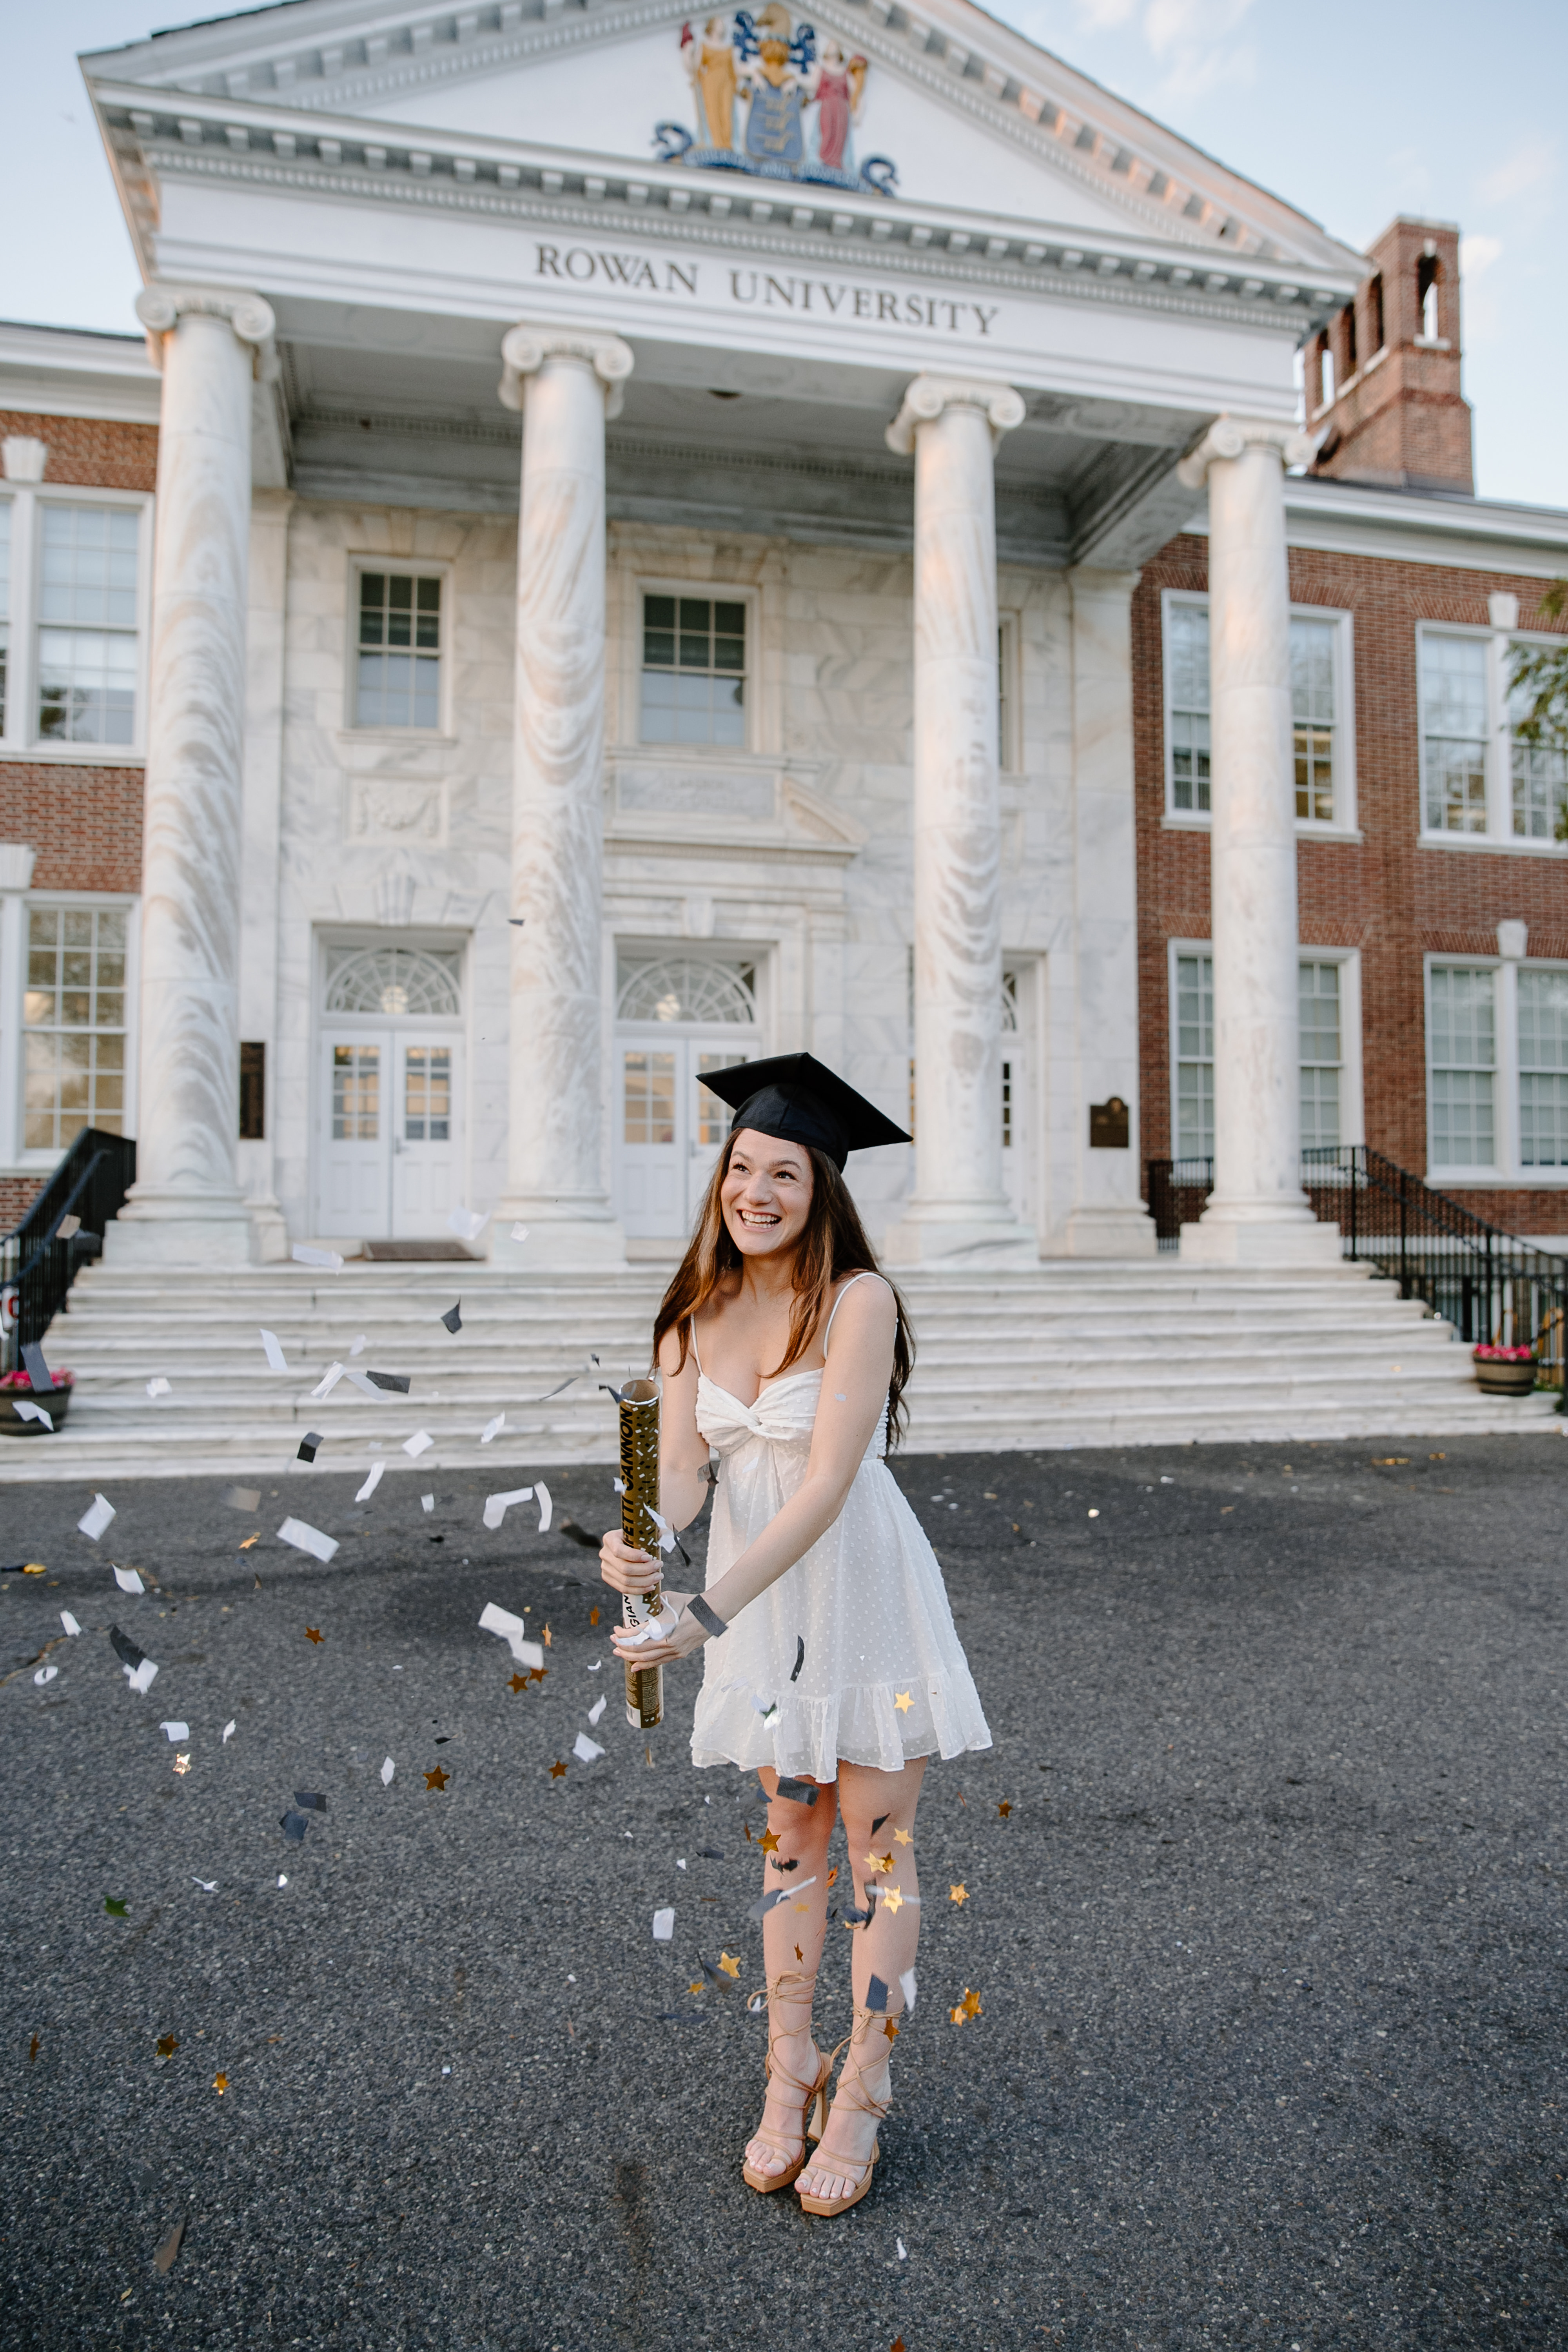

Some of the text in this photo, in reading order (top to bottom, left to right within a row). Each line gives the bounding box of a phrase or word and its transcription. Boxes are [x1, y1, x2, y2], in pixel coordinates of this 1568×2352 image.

[535, 243, 1000, 335] ROWAN UNIVERSITY
[620, 1405, 634, 1548] FETTI CANNON
[624, 1594, 640, 1627] GIAN
